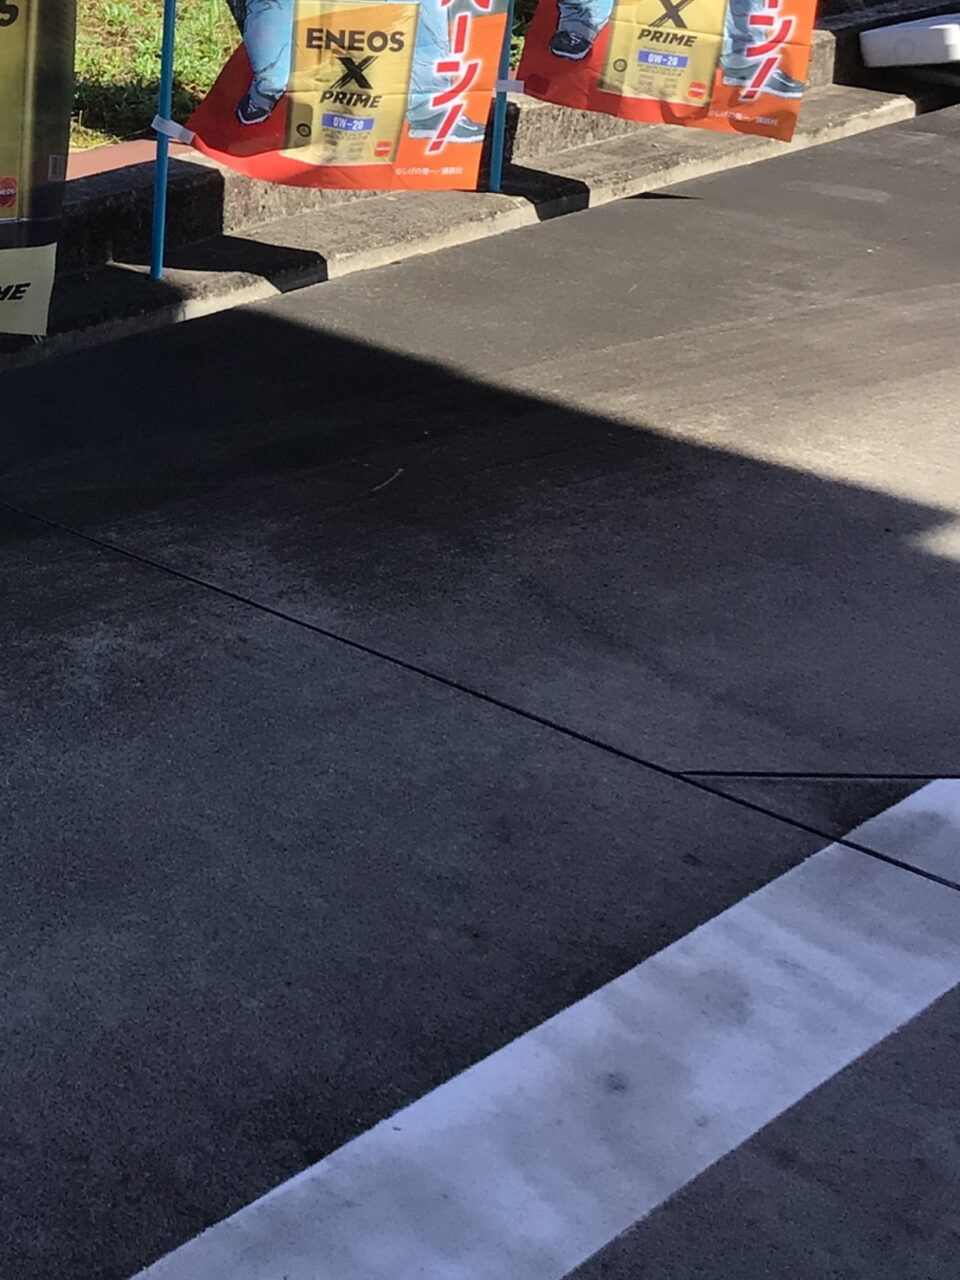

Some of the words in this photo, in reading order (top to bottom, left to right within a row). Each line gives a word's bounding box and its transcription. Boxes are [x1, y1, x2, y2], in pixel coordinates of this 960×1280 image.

[306, 28, 405, 52] ENEOS
[638, 29, 697, 47] PRIME
[648, 53, 679, 66] 0W-20
[329, 55, 379, 90] X
[319, 91, 382, 109] PRIME
[333, 116, 365, 130] 0W-20
